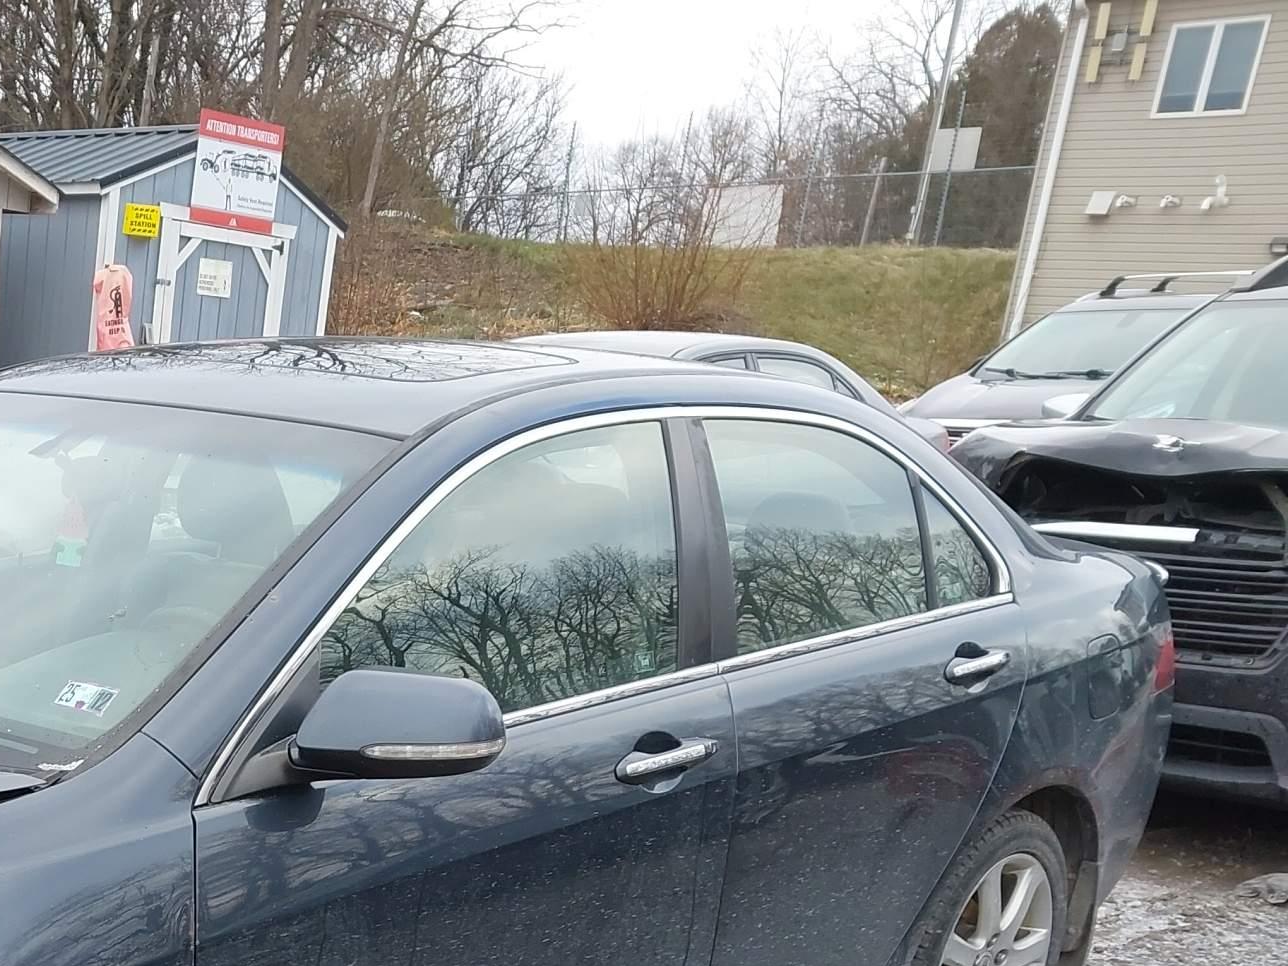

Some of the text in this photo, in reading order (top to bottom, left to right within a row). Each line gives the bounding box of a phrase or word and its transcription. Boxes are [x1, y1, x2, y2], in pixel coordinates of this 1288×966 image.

[206, 119, 236, 136] ATTENTION
[135, 212, 152, 220] SPILL
[129, 220, 156, 229] STATION
[58, 683, 114, 711] 25 12
